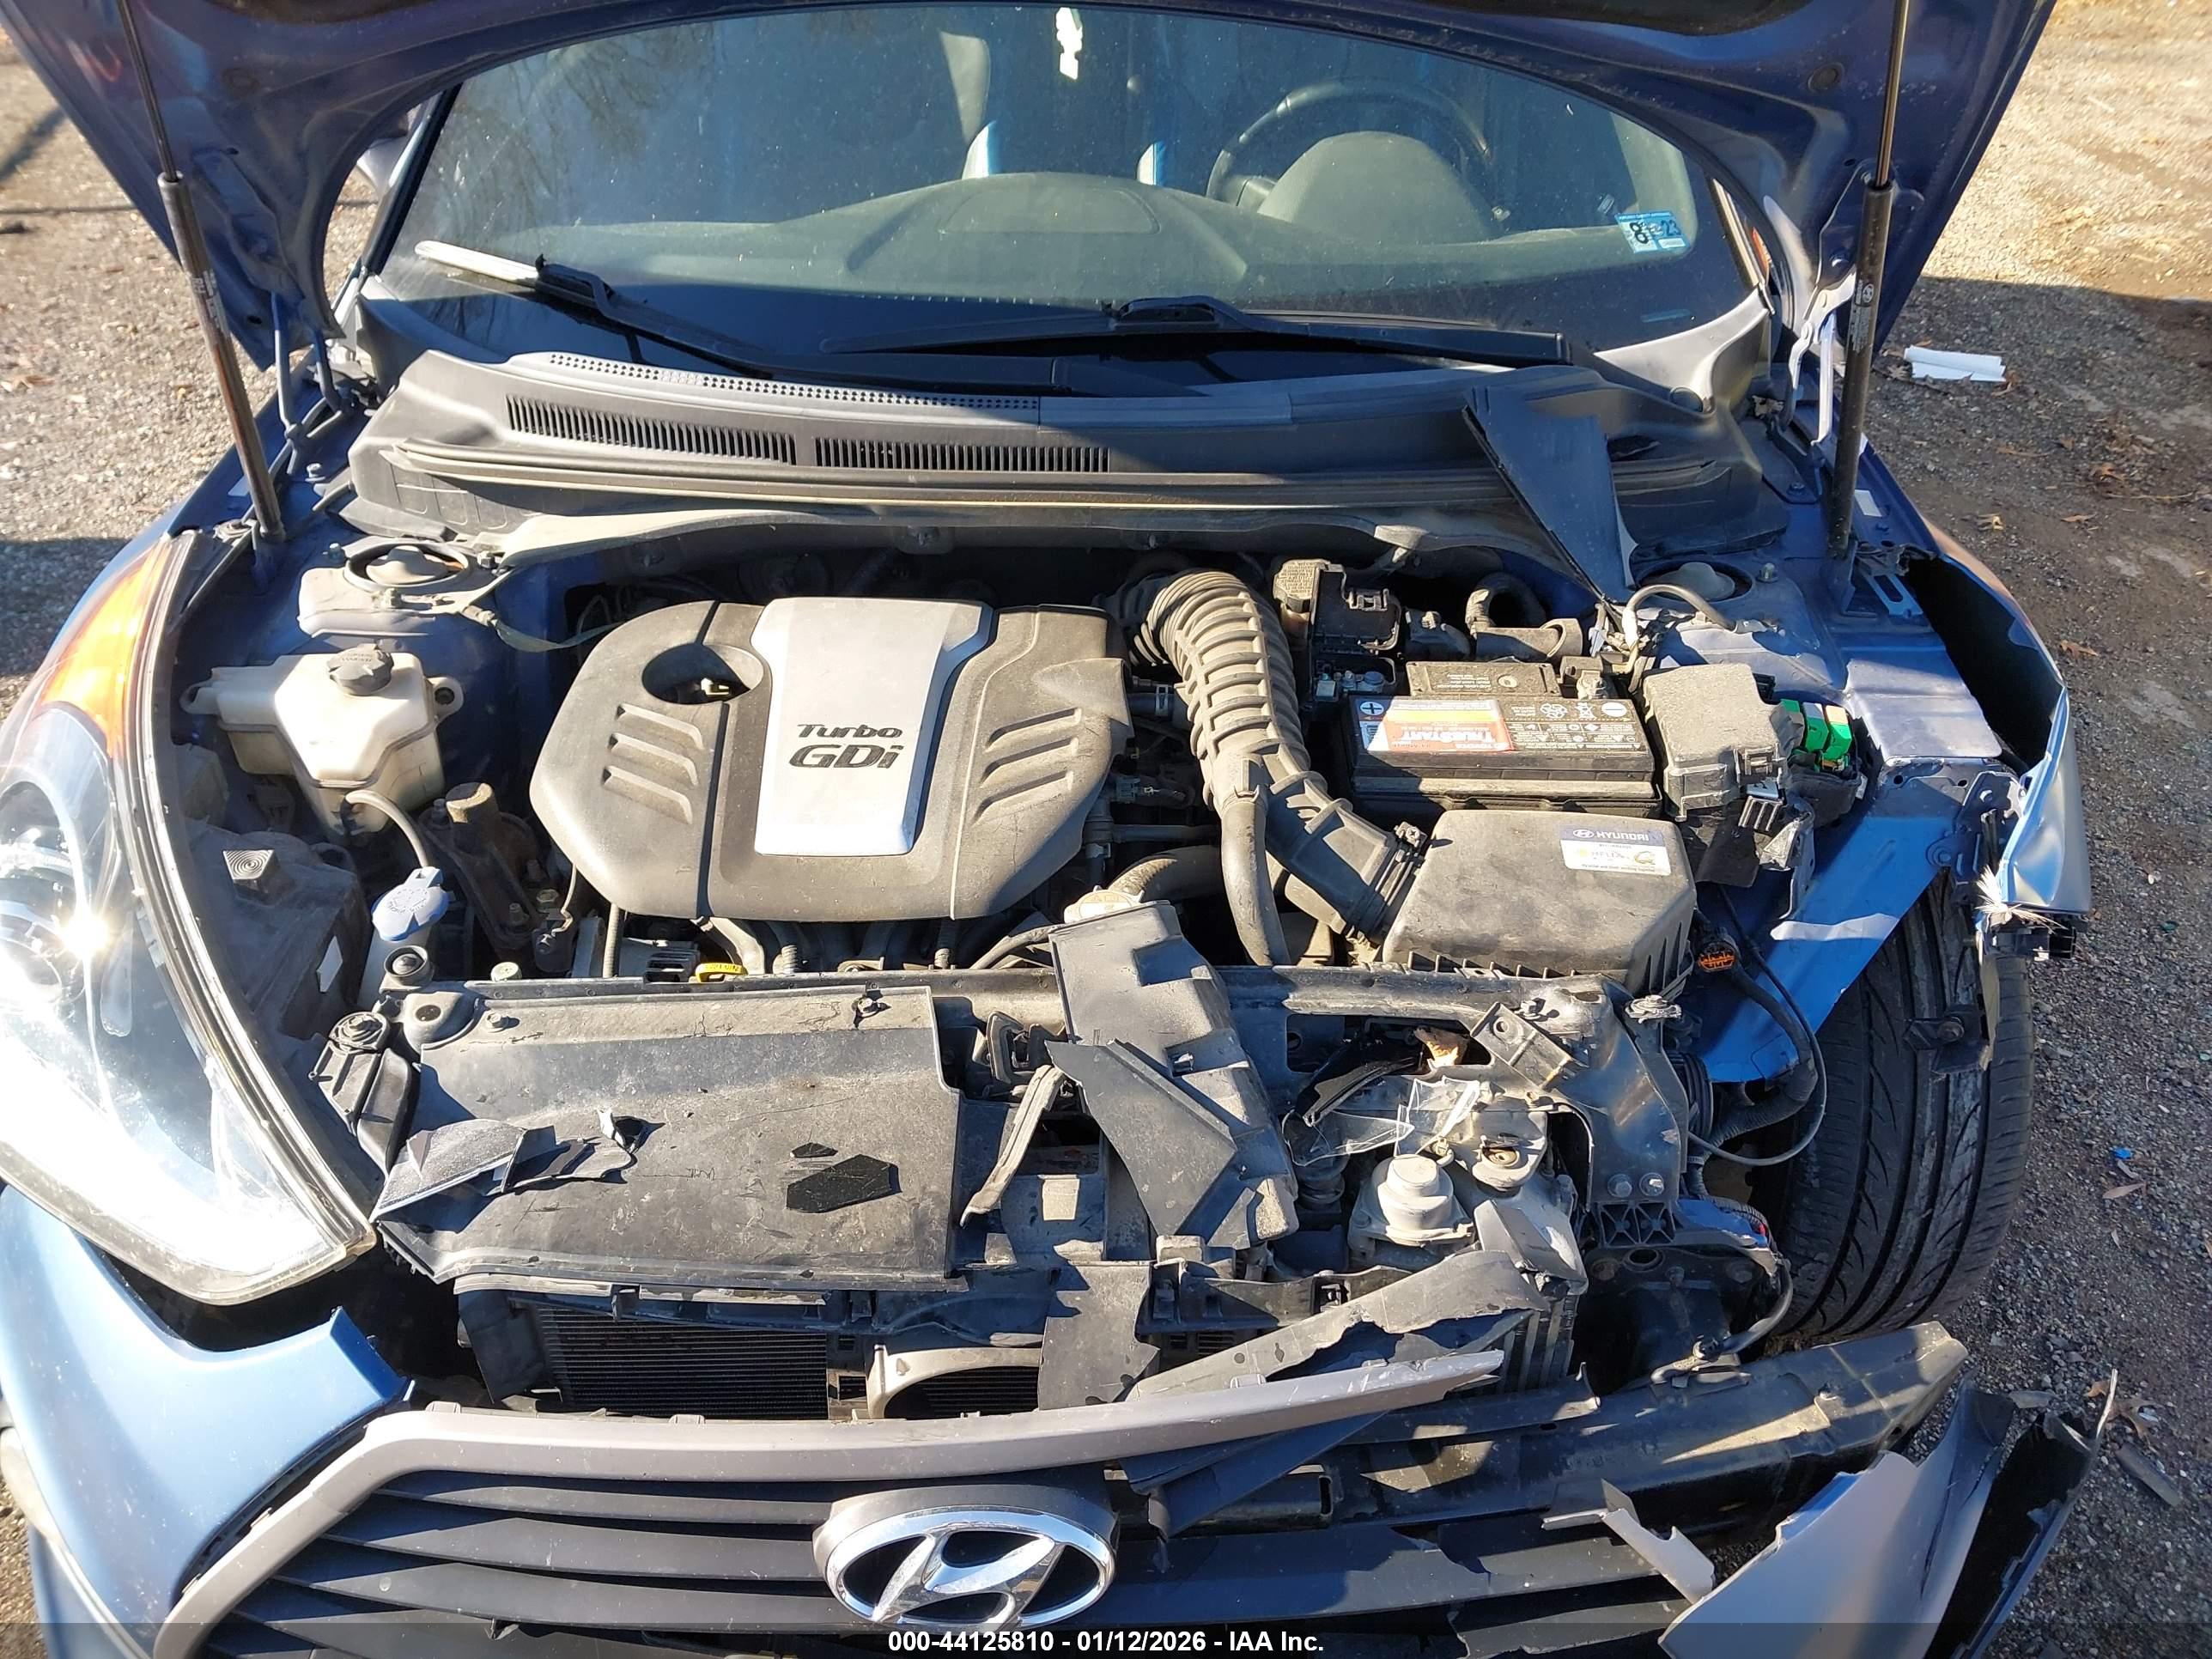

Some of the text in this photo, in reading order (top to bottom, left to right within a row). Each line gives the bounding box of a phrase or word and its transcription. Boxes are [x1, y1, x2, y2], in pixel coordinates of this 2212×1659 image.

[1660, 219, 1681, 237] 23
[797, 722, 902, 739] Turbo
[788, 744, 904, 769] GDi
[1595, 830, 1650, 842] HYUNDAI
